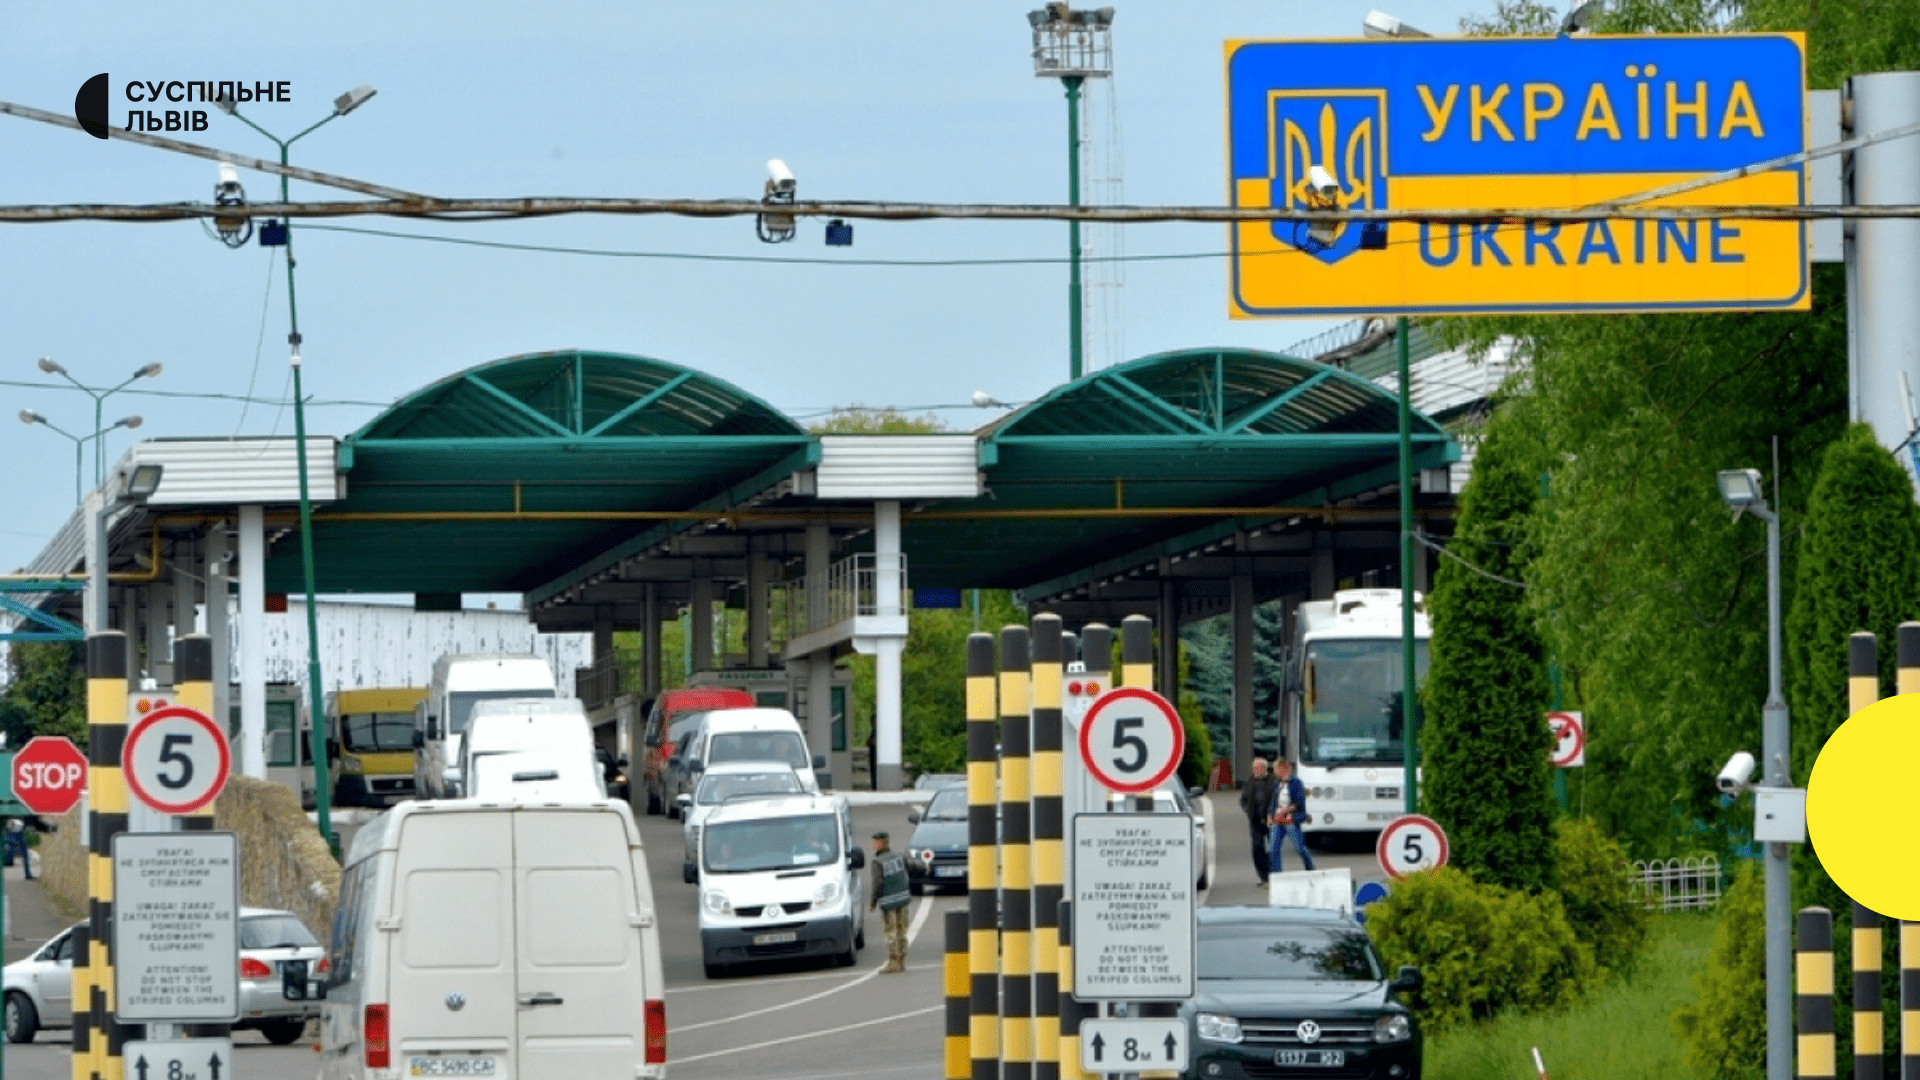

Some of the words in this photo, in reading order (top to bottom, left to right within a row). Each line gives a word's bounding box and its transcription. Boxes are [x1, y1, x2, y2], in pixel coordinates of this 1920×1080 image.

[1416, 64, 1765, 142] УКРАЇНА
[1417, 214, 1747, 268] UKRAINE
[156, 734, 194, 789] 5
[1112, 717, 1149, 774] 5
[18, 763, 82, 789] STOP
[1402, 835, 1423, 864] 5
